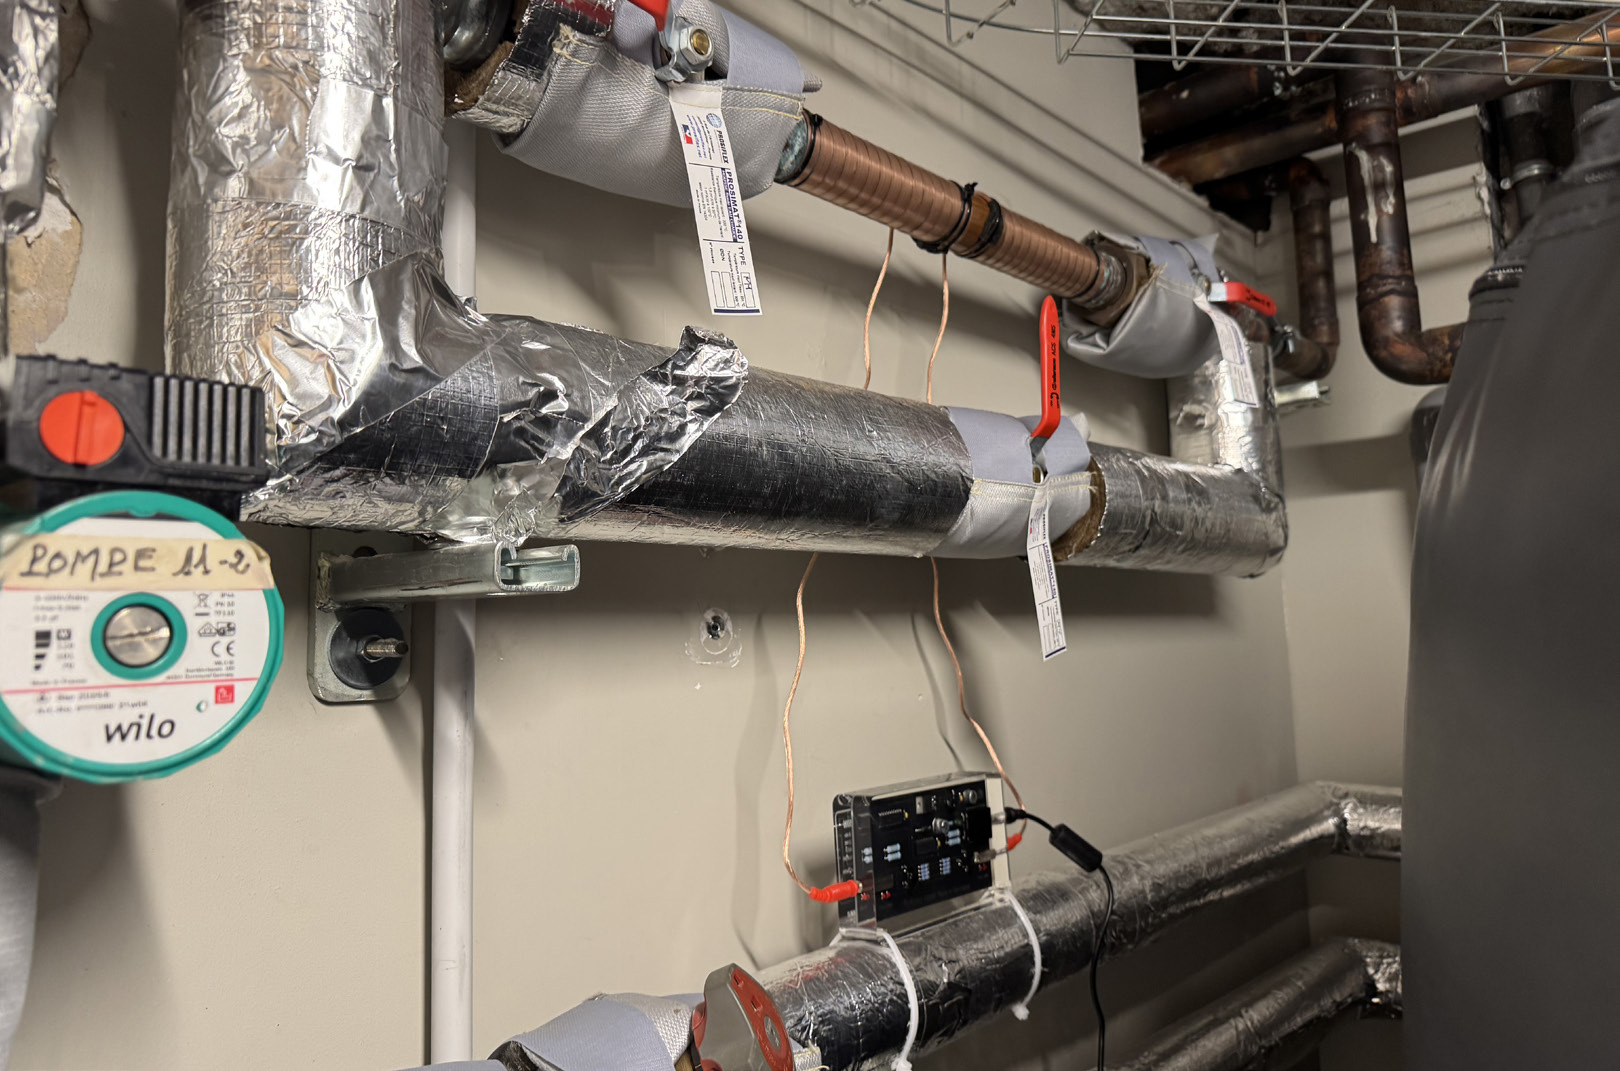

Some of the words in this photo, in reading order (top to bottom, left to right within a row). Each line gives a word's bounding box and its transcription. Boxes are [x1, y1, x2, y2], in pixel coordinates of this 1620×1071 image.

[738, 246, 746, 265] TYPE
[20, 542, 156, 582] POMPE
[105, 712, 176, 743] wilo
